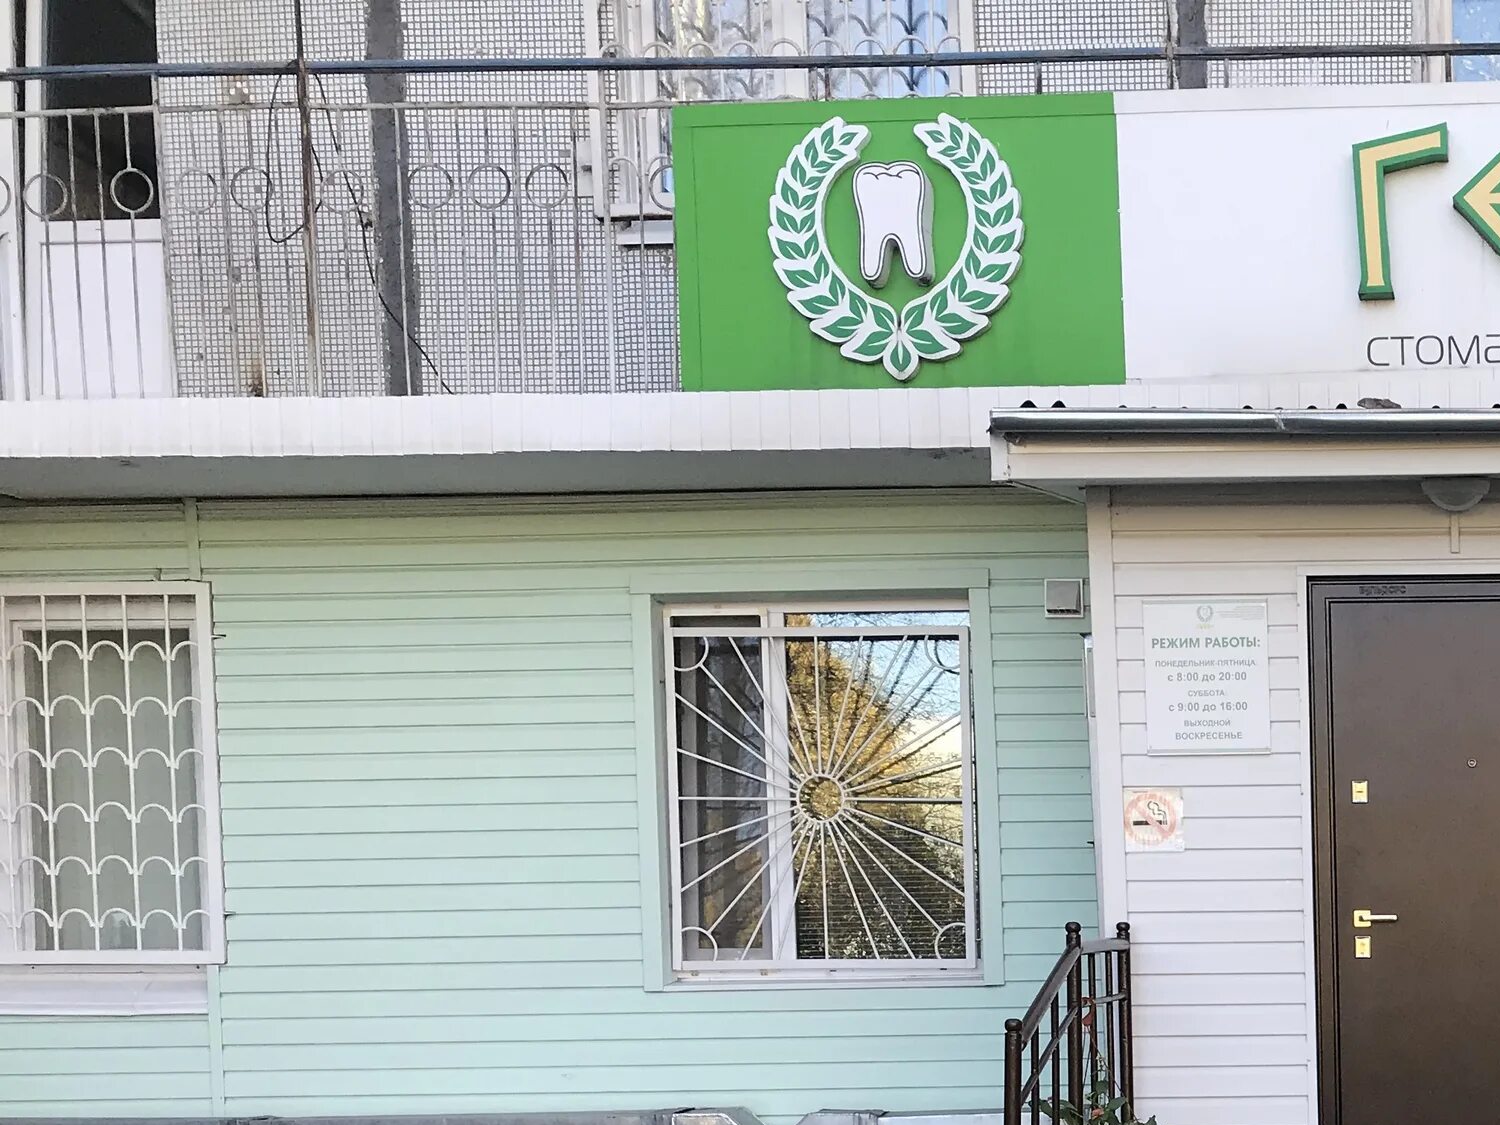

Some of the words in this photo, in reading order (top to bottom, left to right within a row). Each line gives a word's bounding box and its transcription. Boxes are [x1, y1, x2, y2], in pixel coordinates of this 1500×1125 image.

[1151, 637, 1200, 649] РЕЖИМ
[1205, 636, 1261, 648] РАБОТЫ:
[1177, 672, 1199, 682] 8:00
[1201, 674, 1216, 683] до
[1218, 672, 1247, 681] 20:00
[1177, 702, 1200, 712] 9:00
[1202, 703, 1217, 712] до
[1220, 701, 1248, 711] 16:00
[1184, 718, 1231, 727] ВЫХОДНОЙ
[1175, 731, 1243, 740] ВОСКРЕСЕНЬЕ
